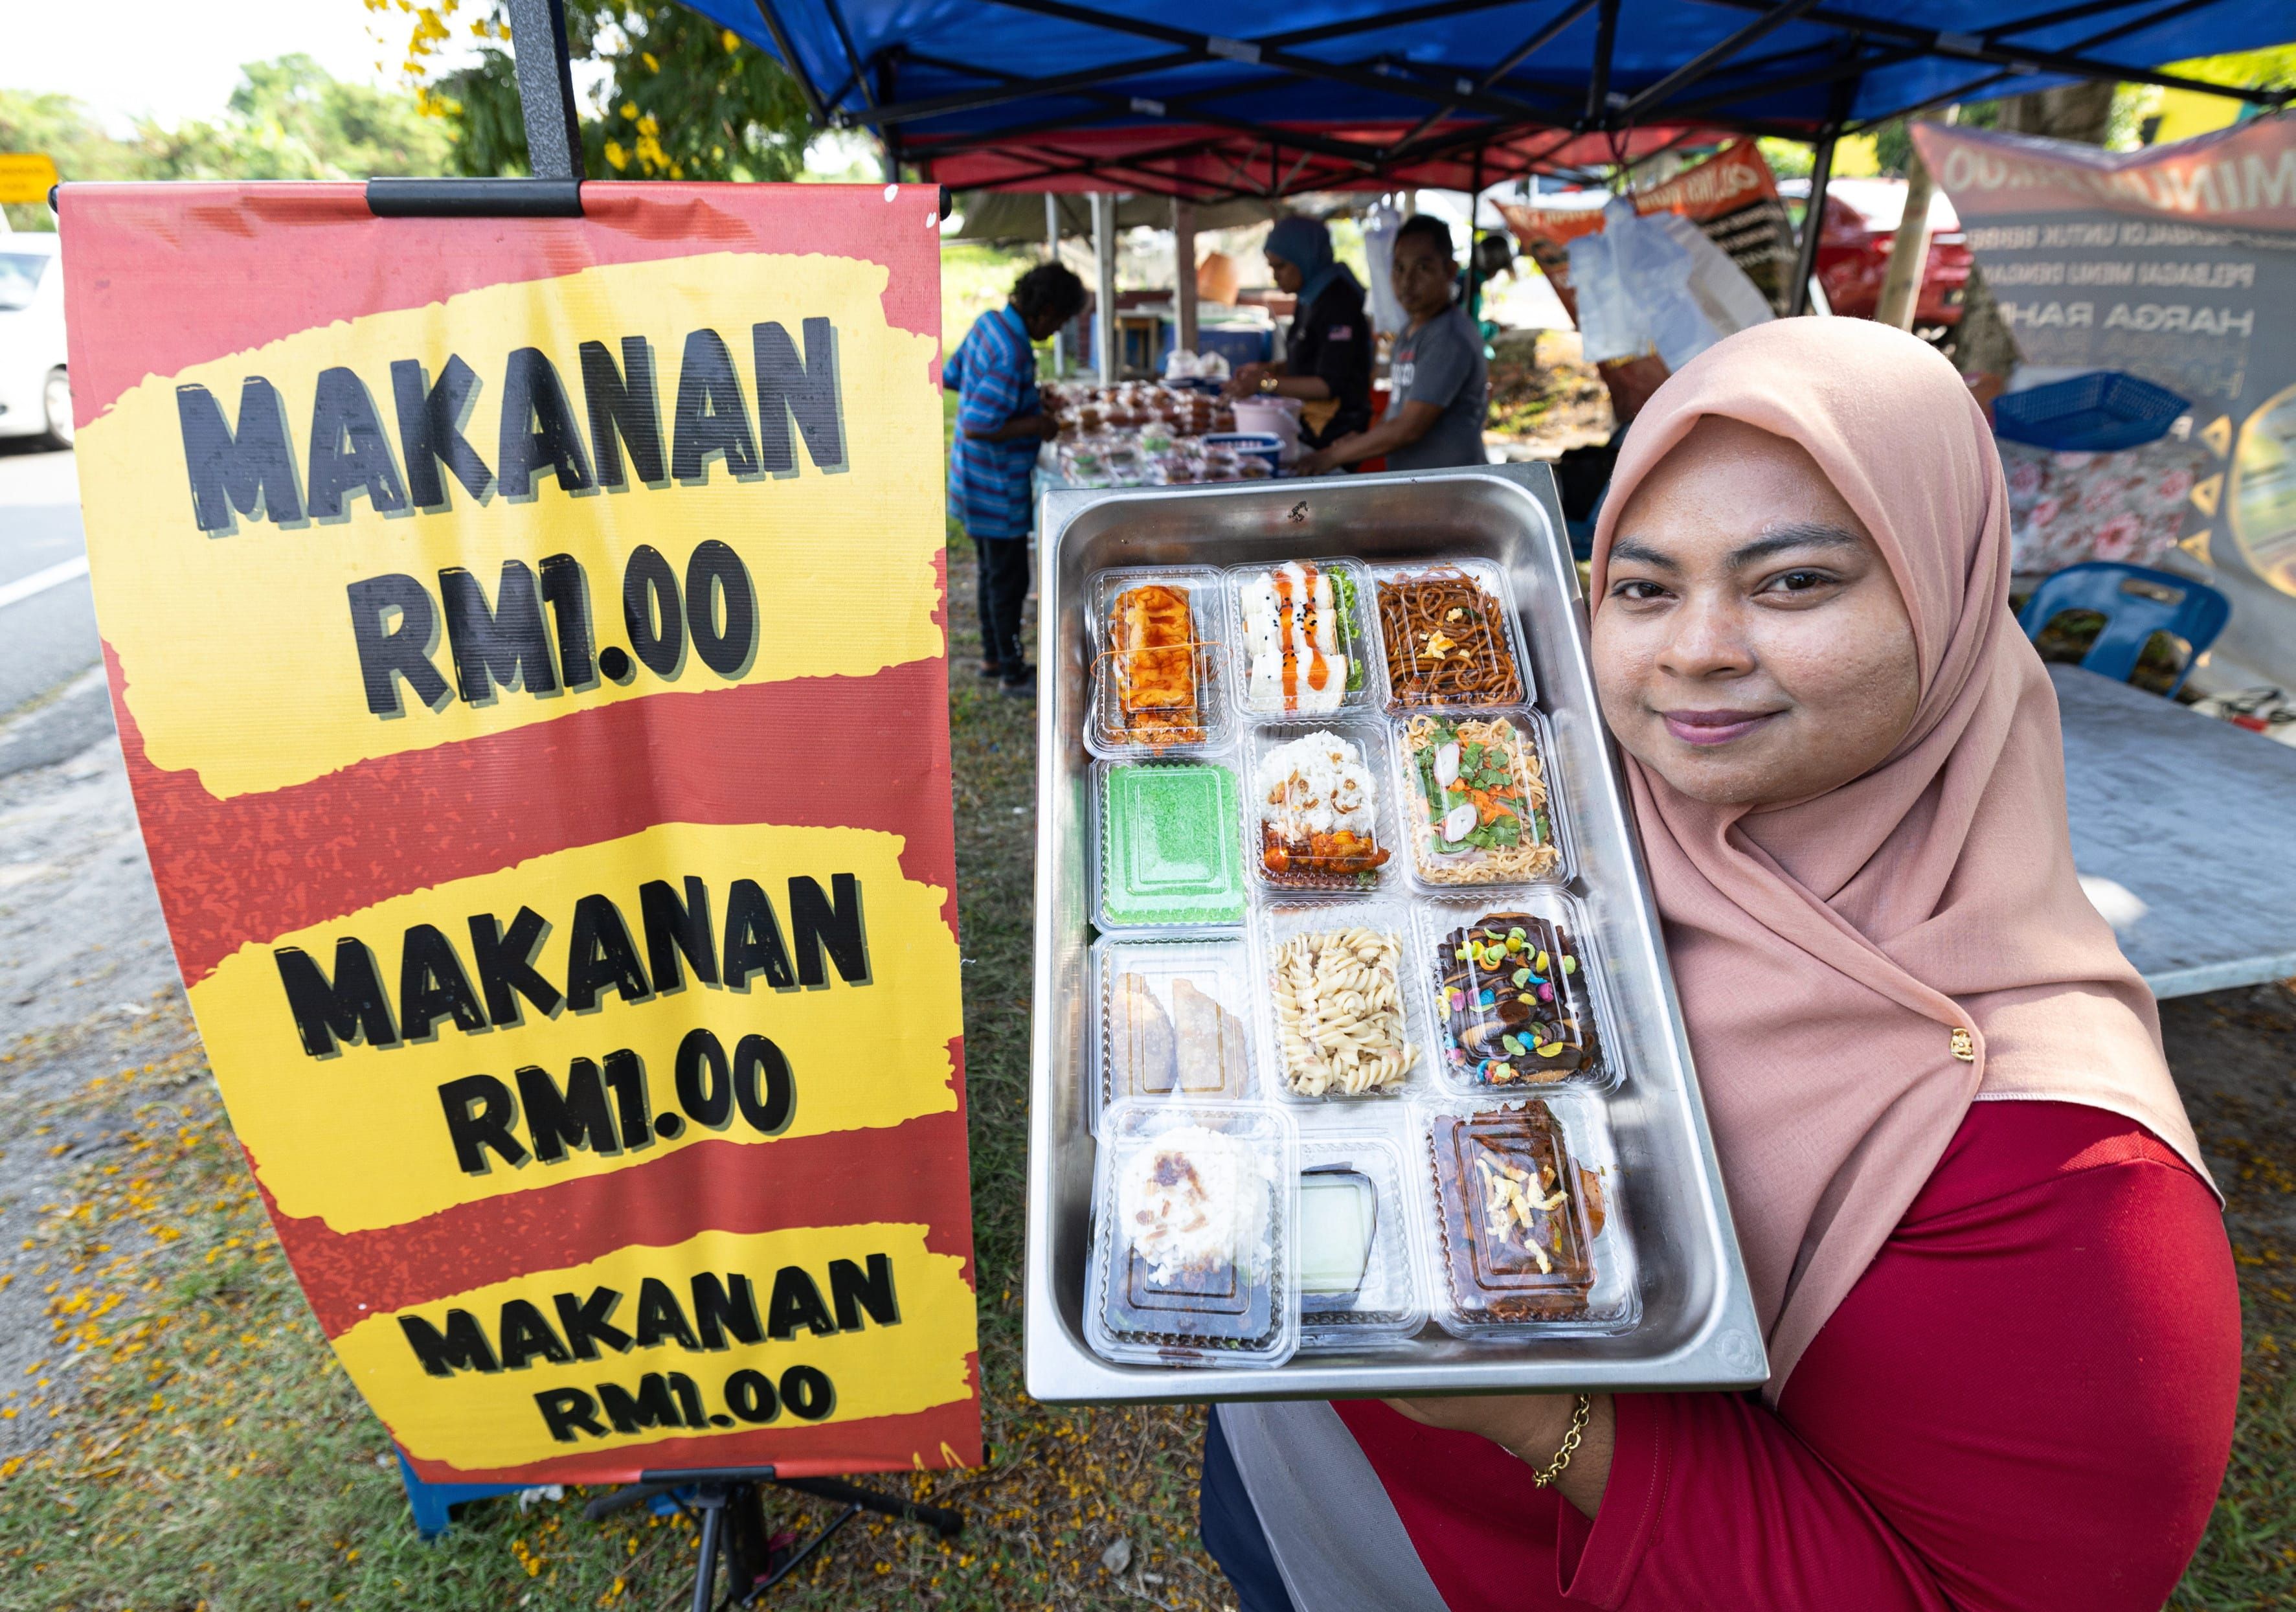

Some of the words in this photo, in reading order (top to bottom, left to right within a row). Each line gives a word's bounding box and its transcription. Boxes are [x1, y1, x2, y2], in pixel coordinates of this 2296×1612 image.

[176, 316, 850, 539] MAKANAN
[346, 539, 760, 720] RM1.00
[274, 872, 873, 1060] MAKANAN
[438, 1028, 797, 1174] RM1.00
[396, 1253, 901, 1378] MAKANAN
[533, 1365, 837, 1443] RM1.00
